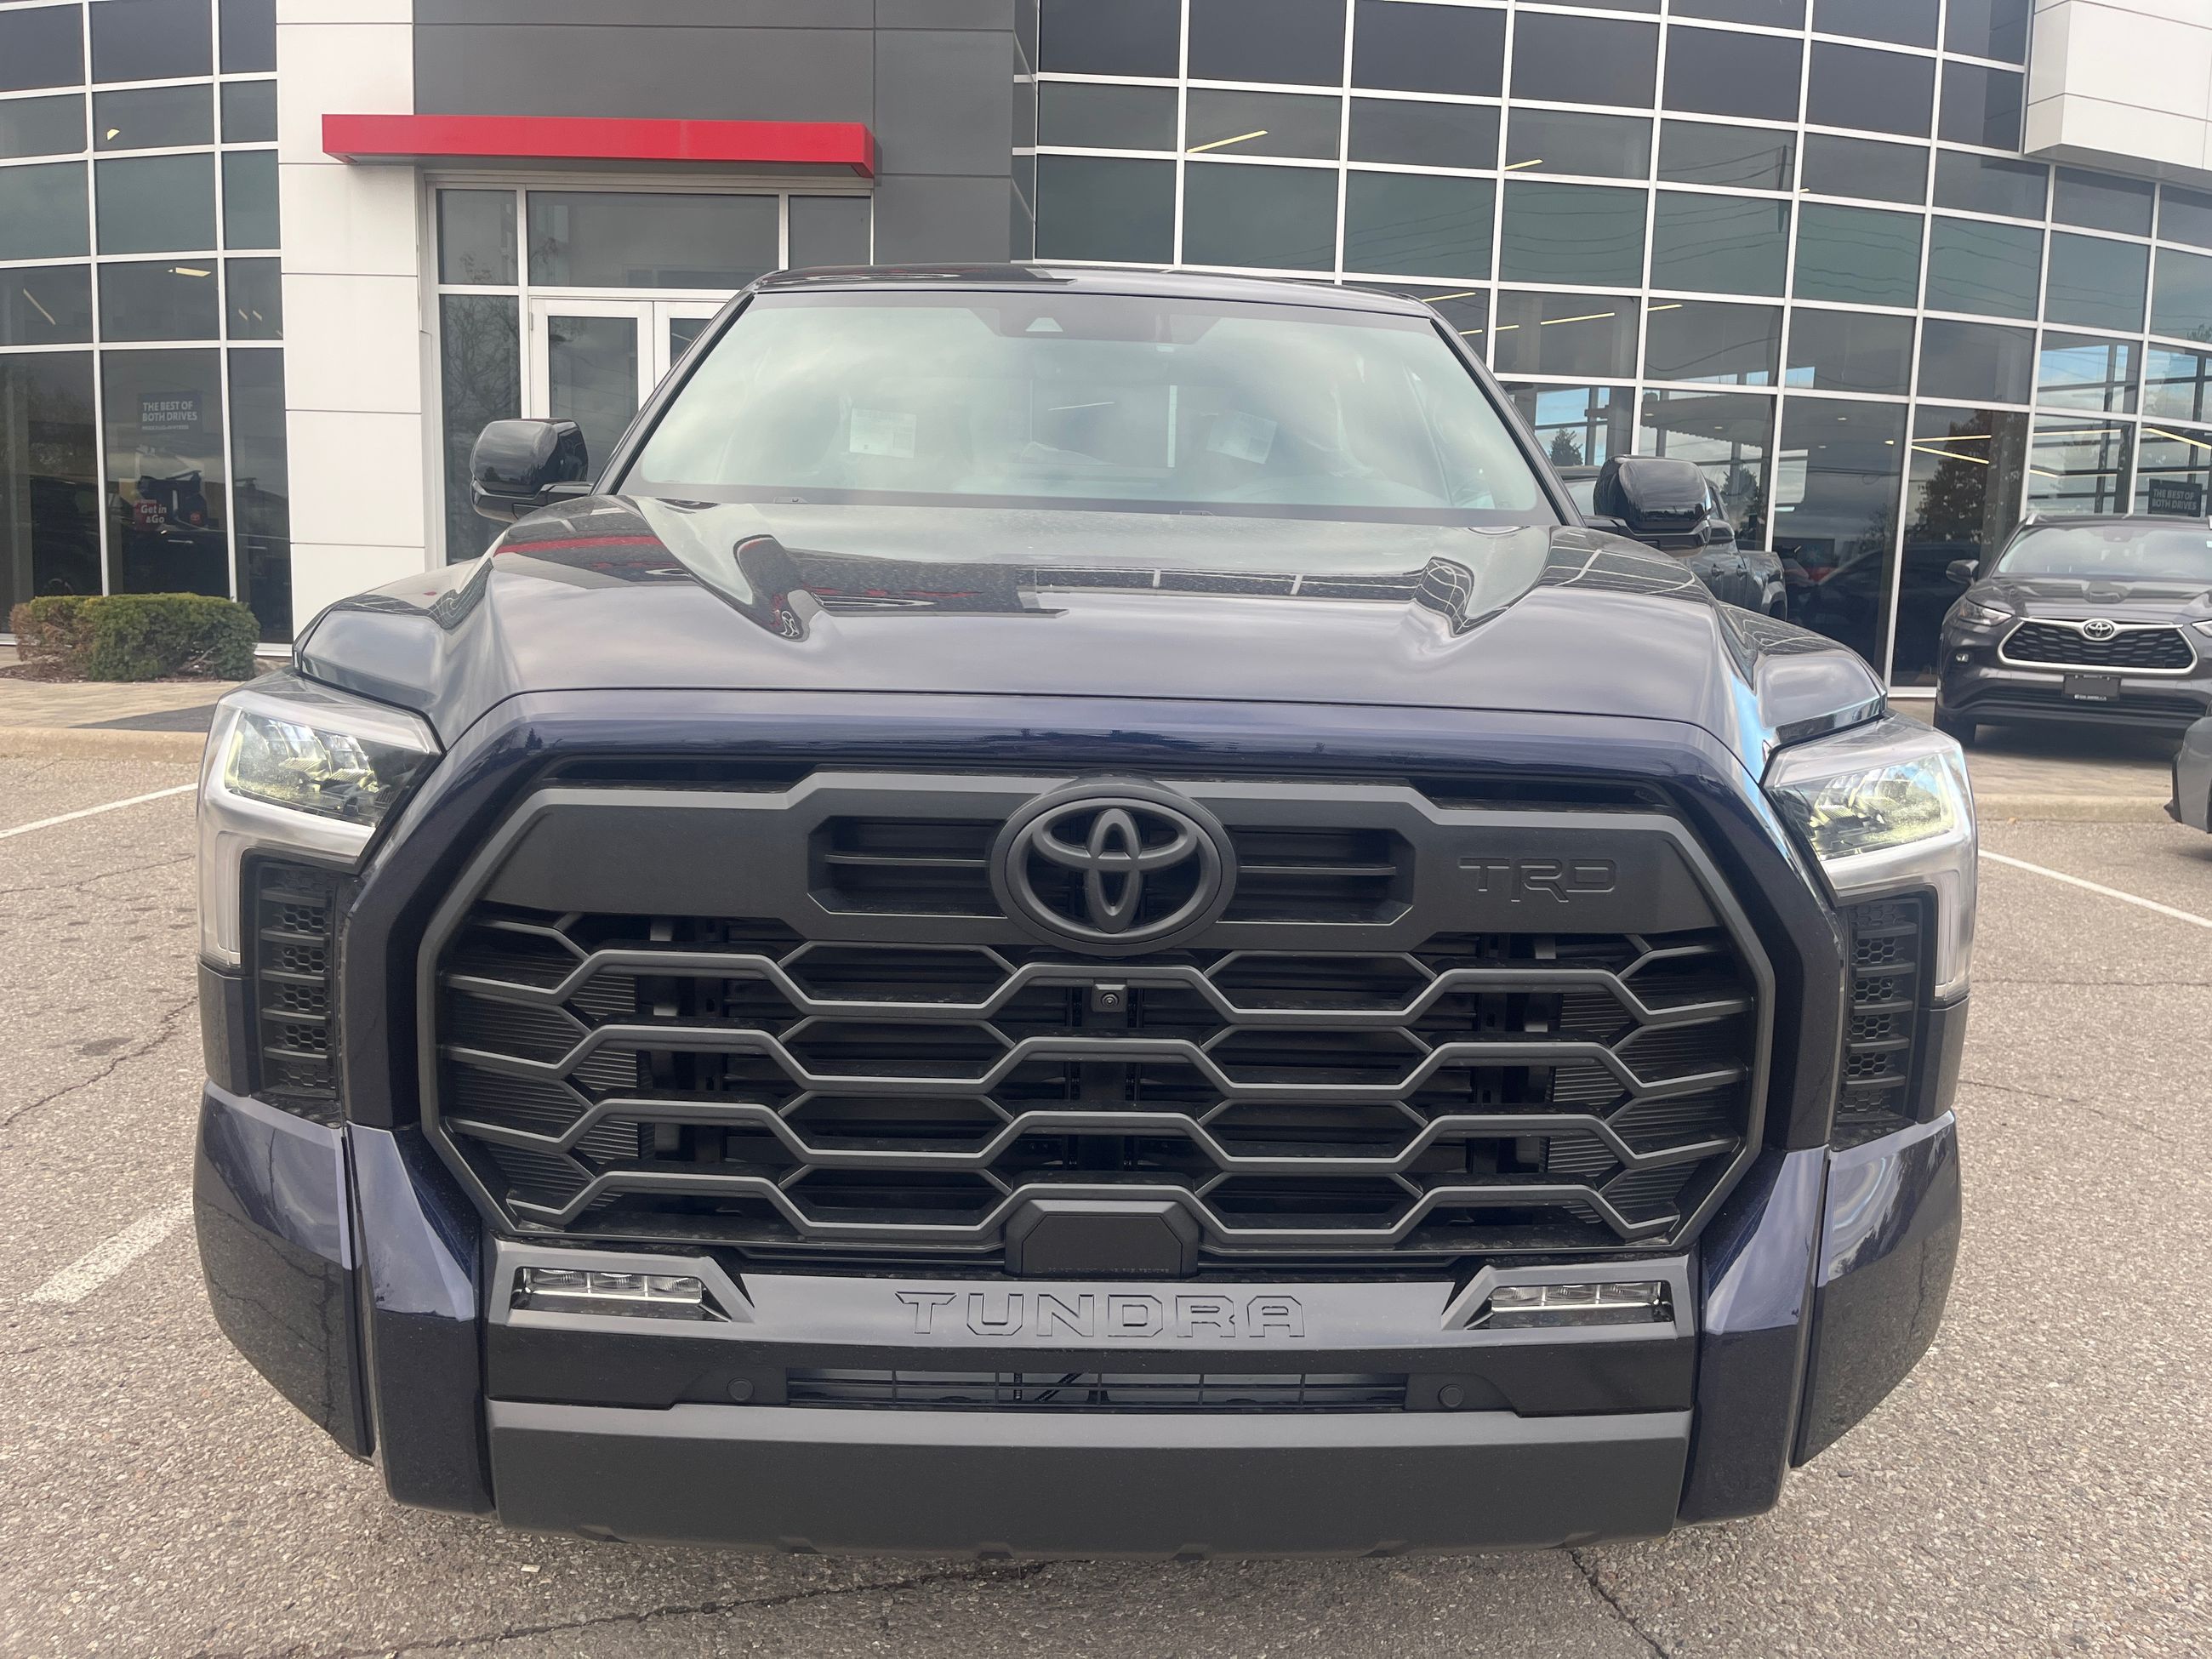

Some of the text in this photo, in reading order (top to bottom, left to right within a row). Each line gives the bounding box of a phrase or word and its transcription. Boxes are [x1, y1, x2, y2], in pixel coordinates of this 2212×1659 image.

[142, 401, 193, 412] THE BEST OF
[142, 412, 197, 422] BOTH DRIVES
[2153, 488, 2195, 500] THE BEST OF
[140, 505, 167, 514] Get in
[2152, 498, 2198, 510] BOTH DRIVES
[1458, 858, 1616, 903] TRD
[894, 1291, 1306, 1338] TUNDRA
